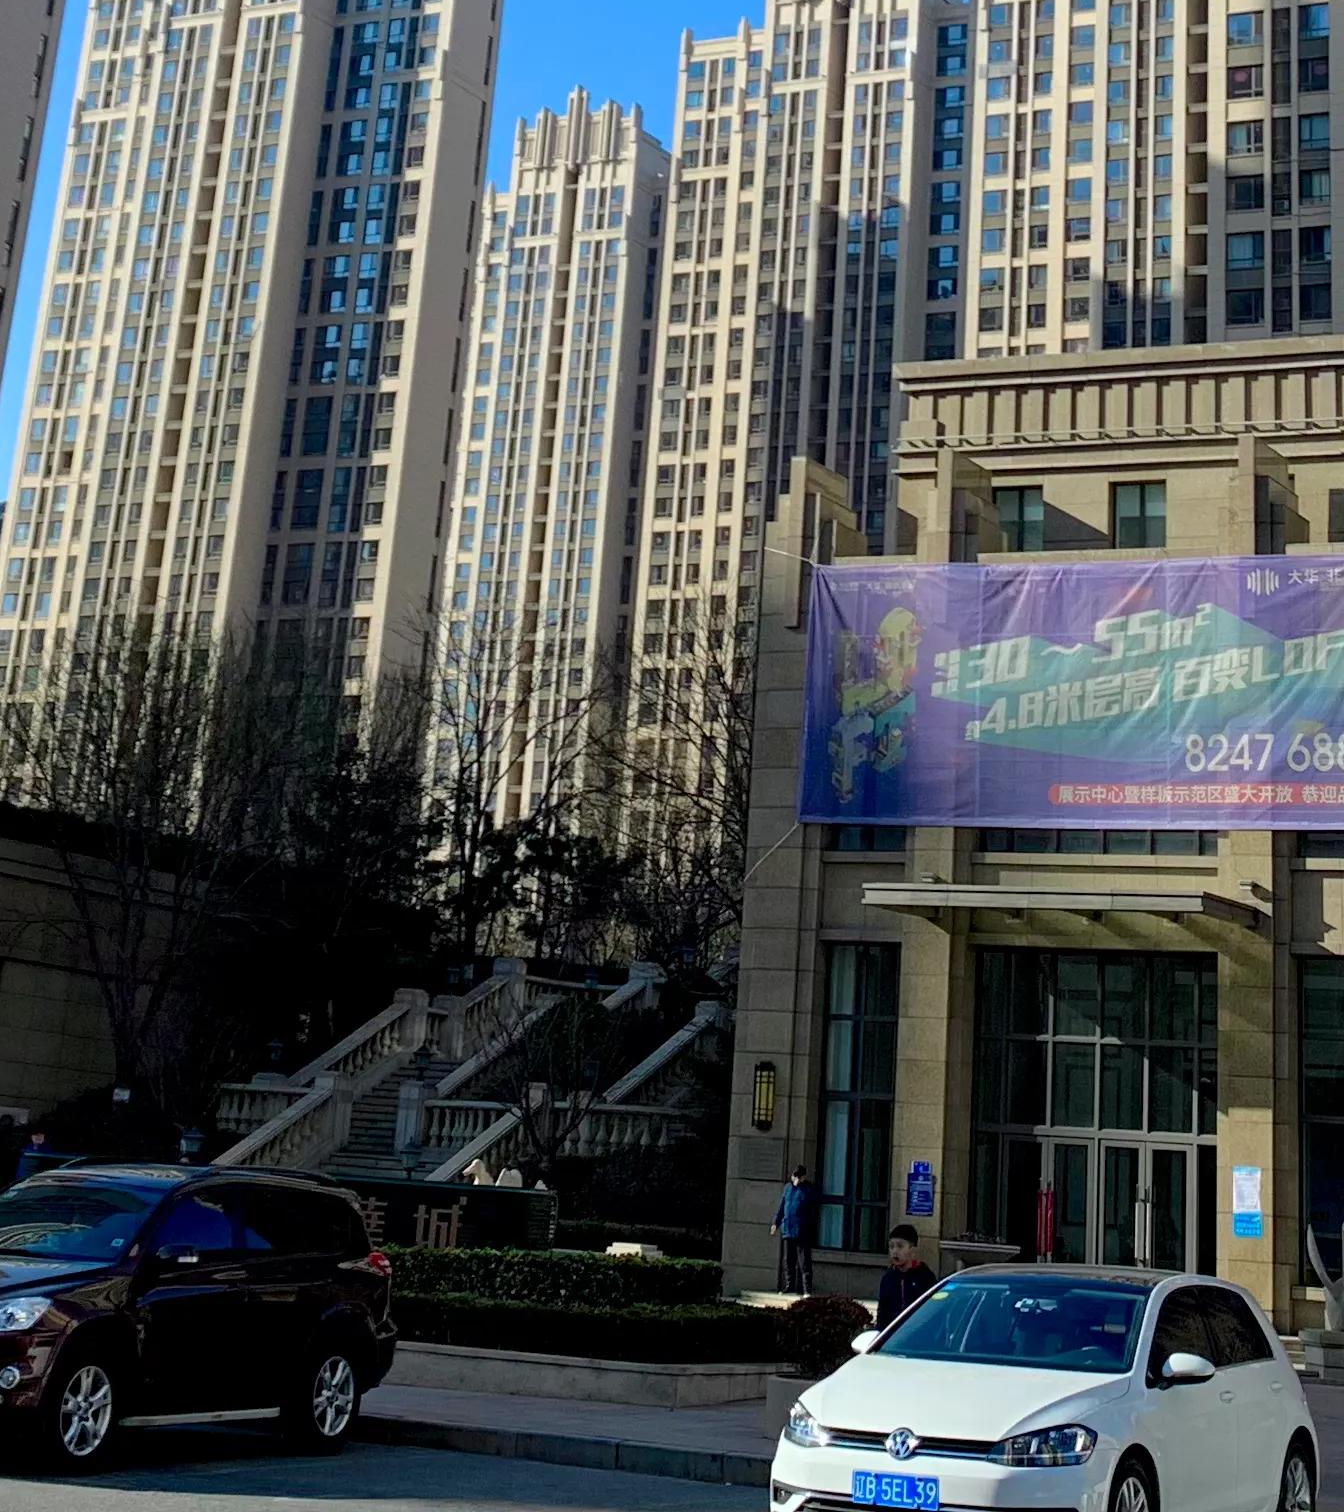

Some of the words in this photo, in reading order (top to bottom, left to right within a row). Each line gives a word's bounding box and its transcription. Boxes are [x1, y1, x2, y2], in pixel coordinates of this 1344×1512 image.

[1185, 733, 1275, 773] 8247
[1058, 785, 1293, 805] 展示中心暨样板示范区盛大开放
